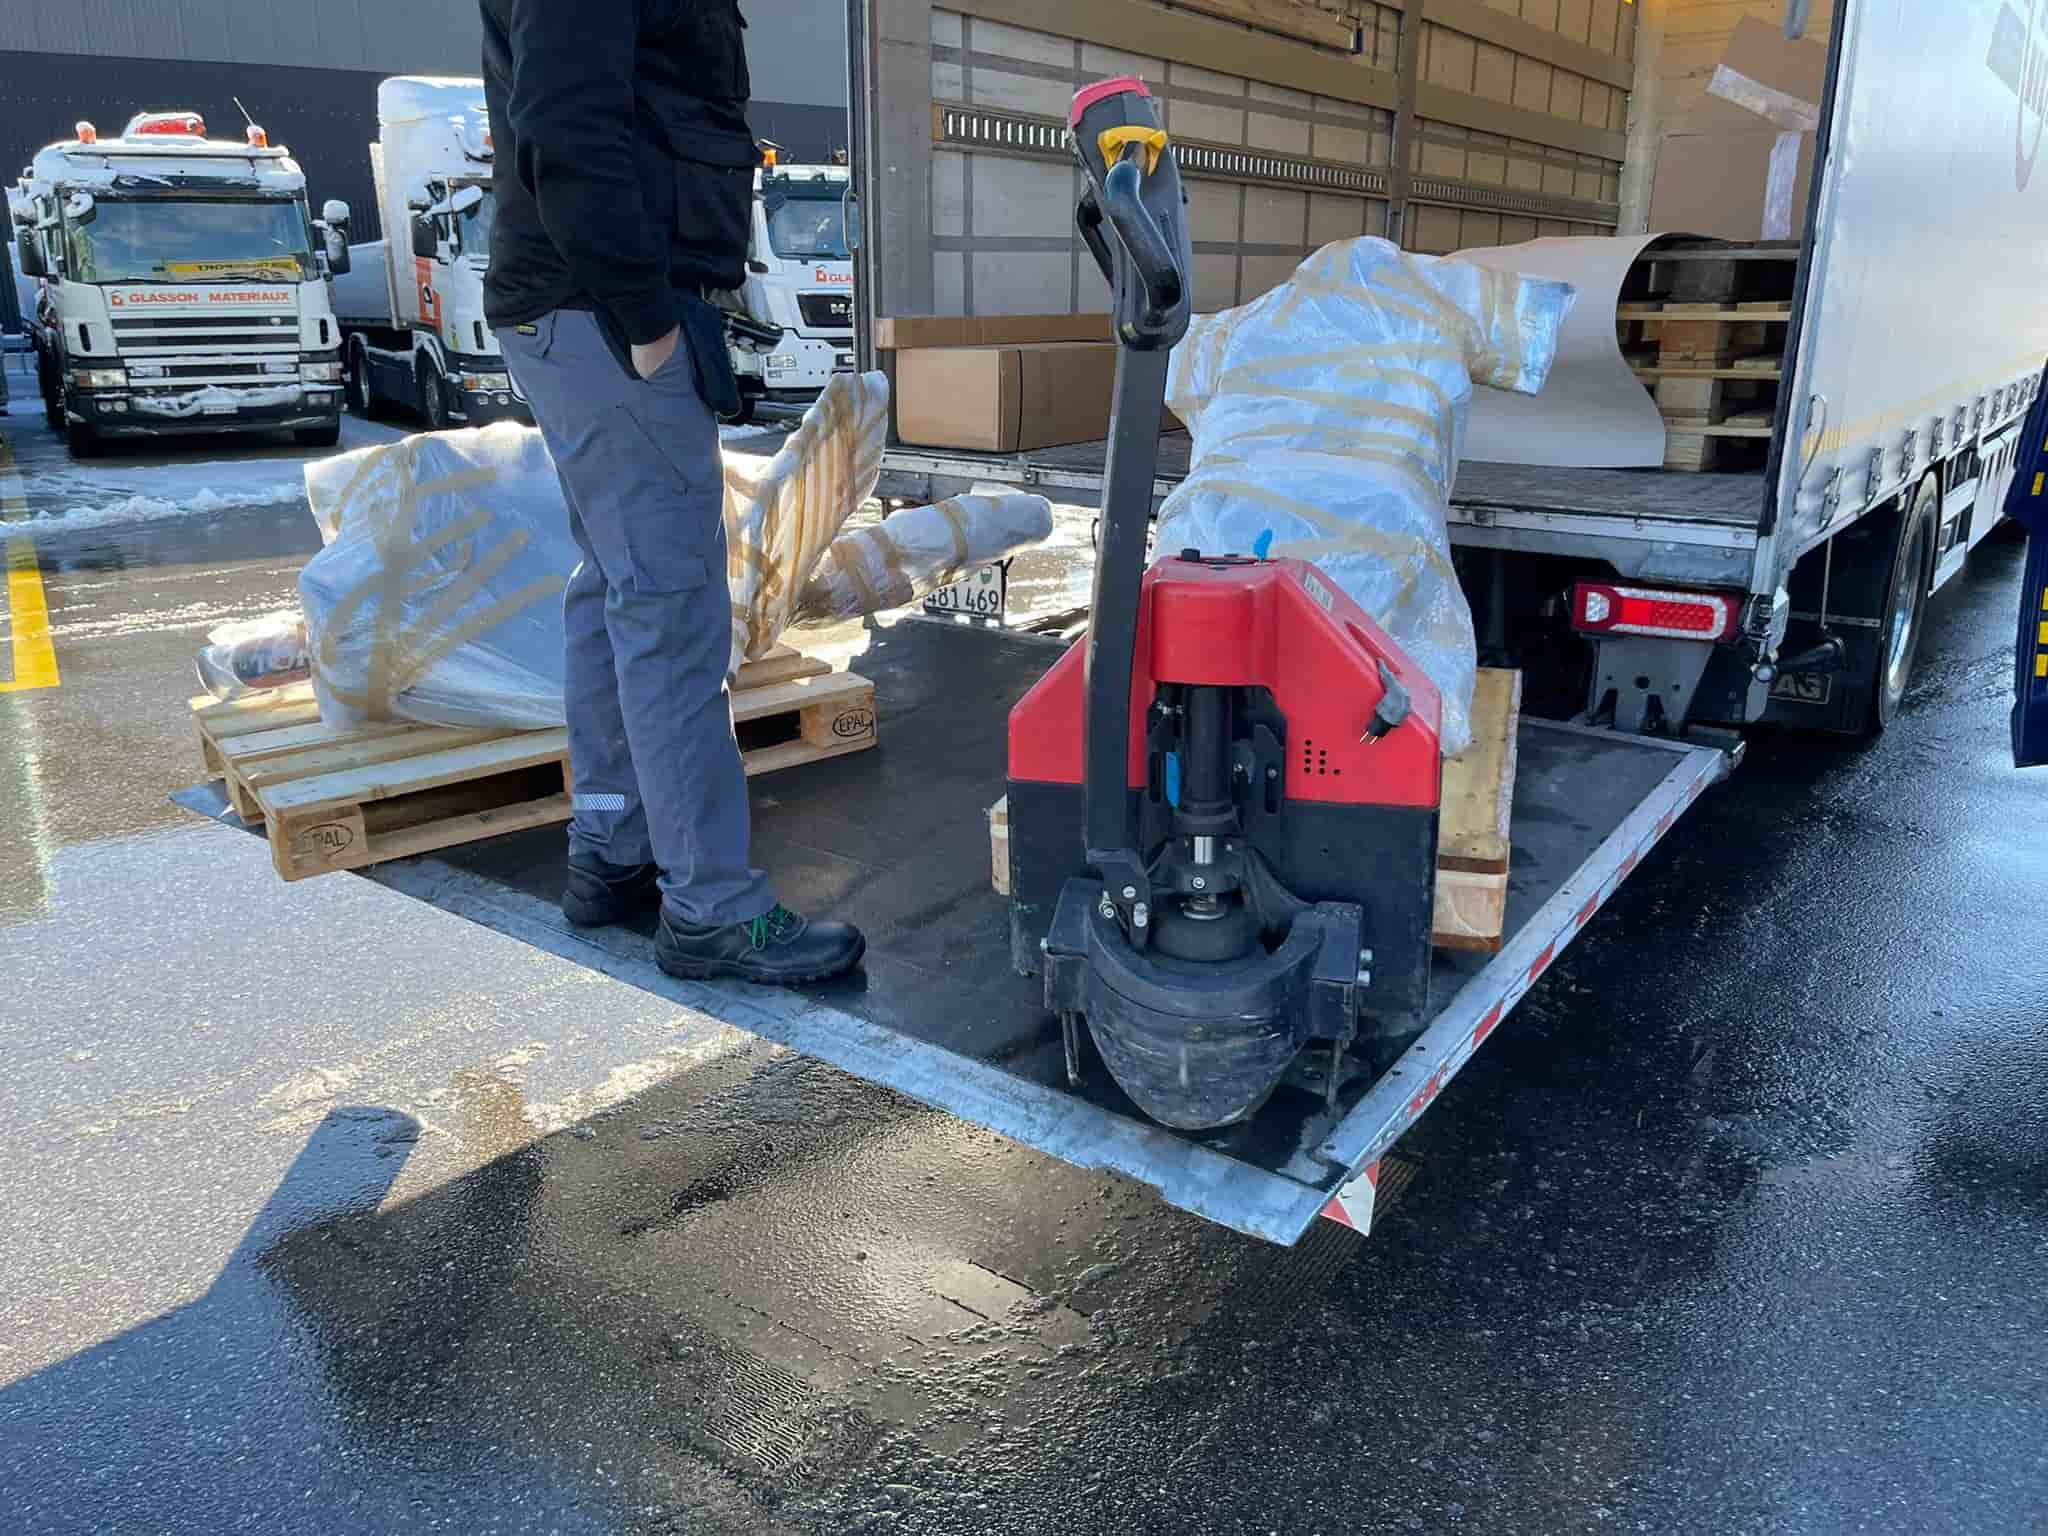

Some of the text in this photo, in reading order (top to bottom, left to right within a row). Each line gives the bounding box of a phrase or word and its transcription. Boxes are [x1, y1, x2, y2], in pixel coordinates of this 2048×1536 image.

[129, 291, 289, 304] GLASSON MATERIAUX
[966, 587, 999, 613] 469
[839, 711, 870, 733] EPAL
